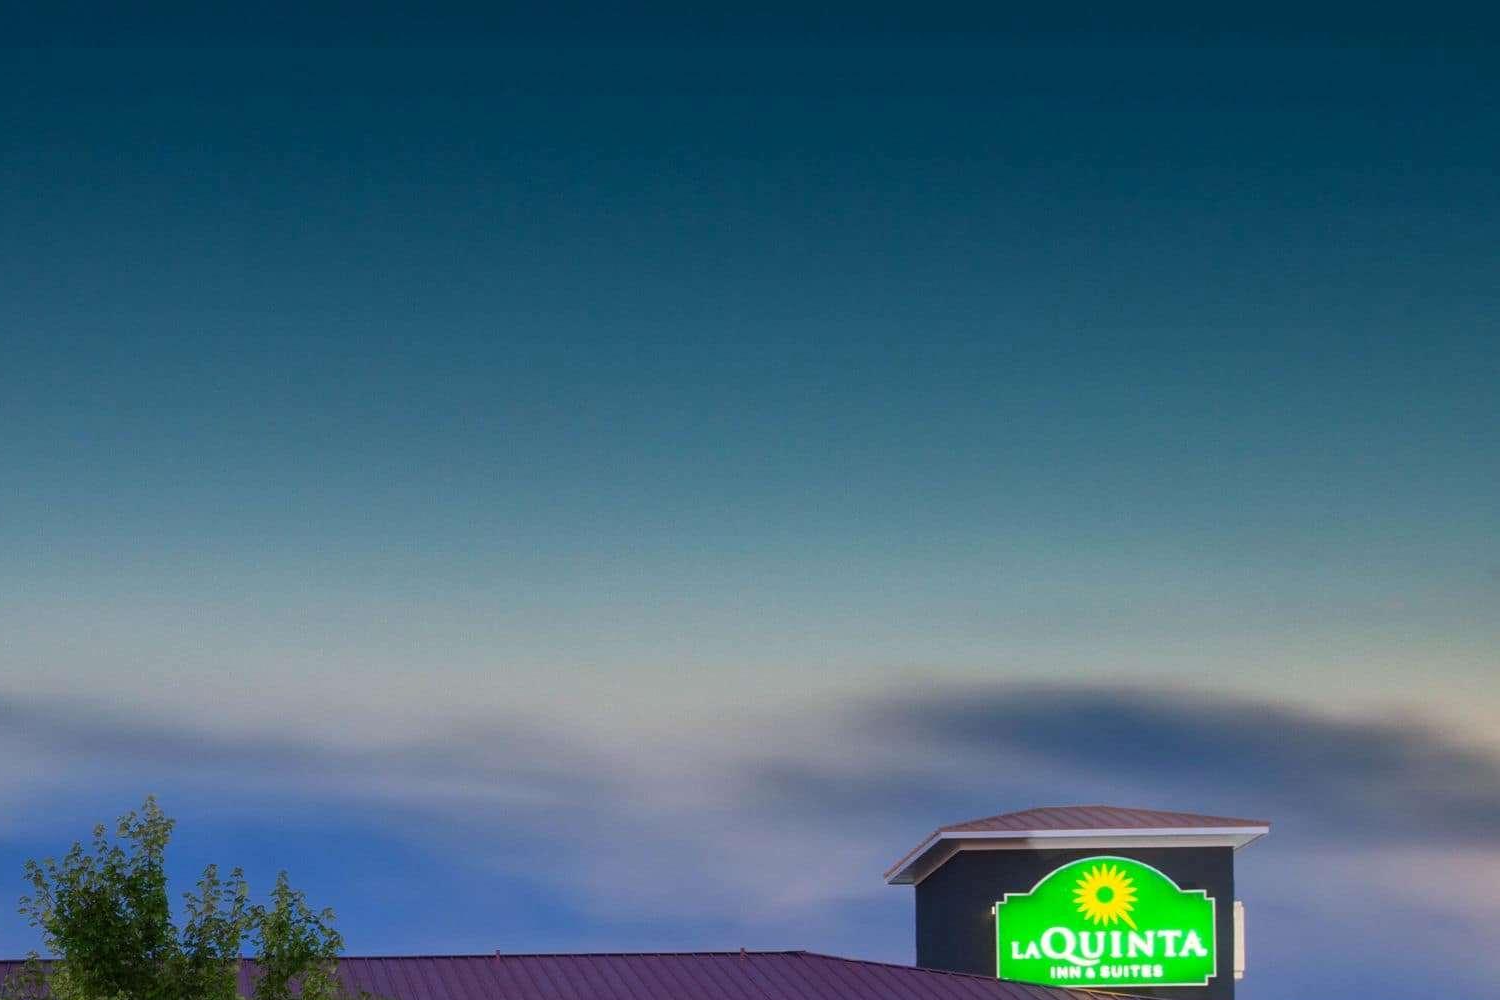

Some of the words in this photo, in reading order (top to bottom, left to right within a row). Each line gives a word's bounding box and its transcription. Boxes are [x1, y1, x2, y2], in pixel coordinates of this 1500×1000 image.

[1040, 927, 1208, 966] QUINTA
[1050, 967, 1081, 978] INN
[1085, 967, 1096, 978] &
[1100, 964, 1163, 977] SUITES
